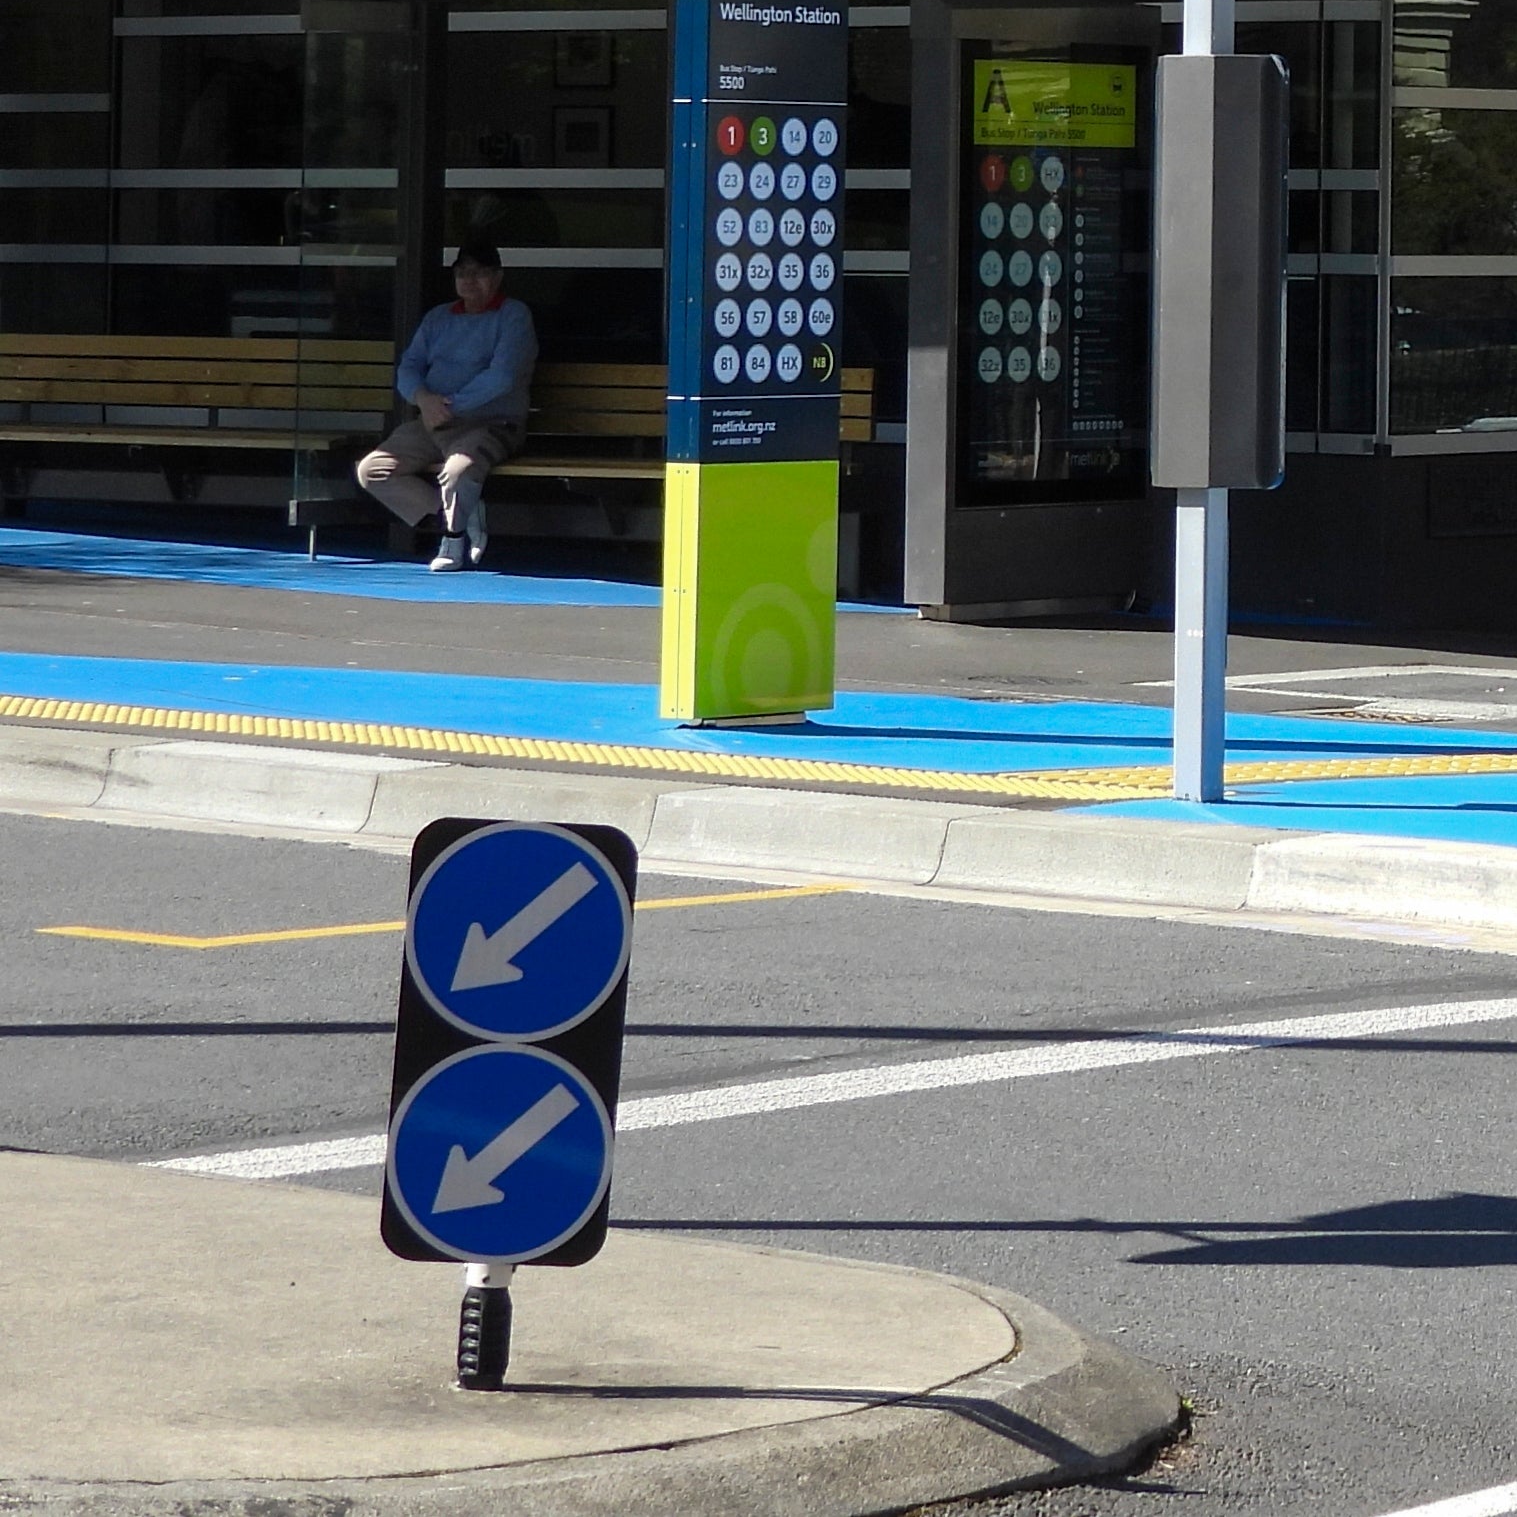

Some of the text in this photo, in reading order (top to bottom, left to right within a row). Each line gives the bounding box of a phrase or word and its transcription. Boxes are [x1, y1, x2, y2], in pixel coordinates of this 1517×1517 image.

[720, 3, 841, 25] Wellington Station
[720, 75, 745, 89] 5500
[982, 69, 1011, 113] A
[1033, 101, 1126, 118] Wellington Station
[728, 126, 832, 145] 1 3 14 20
[1018, 166, 1025, 181] 3
[1044, 168, 1059, 181] HX
[724, 174, 831, 189] 23 24 27 29
[723, 220, 833, 235] 52 83 12e 30x
[719, 265, 830, 279] 31x 32x 35 36
[721, 310, 831, 325] 56 57 58 60e
[982, 310, 1000, 324] 12e
[721, 357, 734, 370] 81
[751, 357, 765, 370] 84
[781, 357, 798, 370] HX
[1013, 359, 1026, 372] 35
[712, 419, 776, 435] metlink.org.nz
